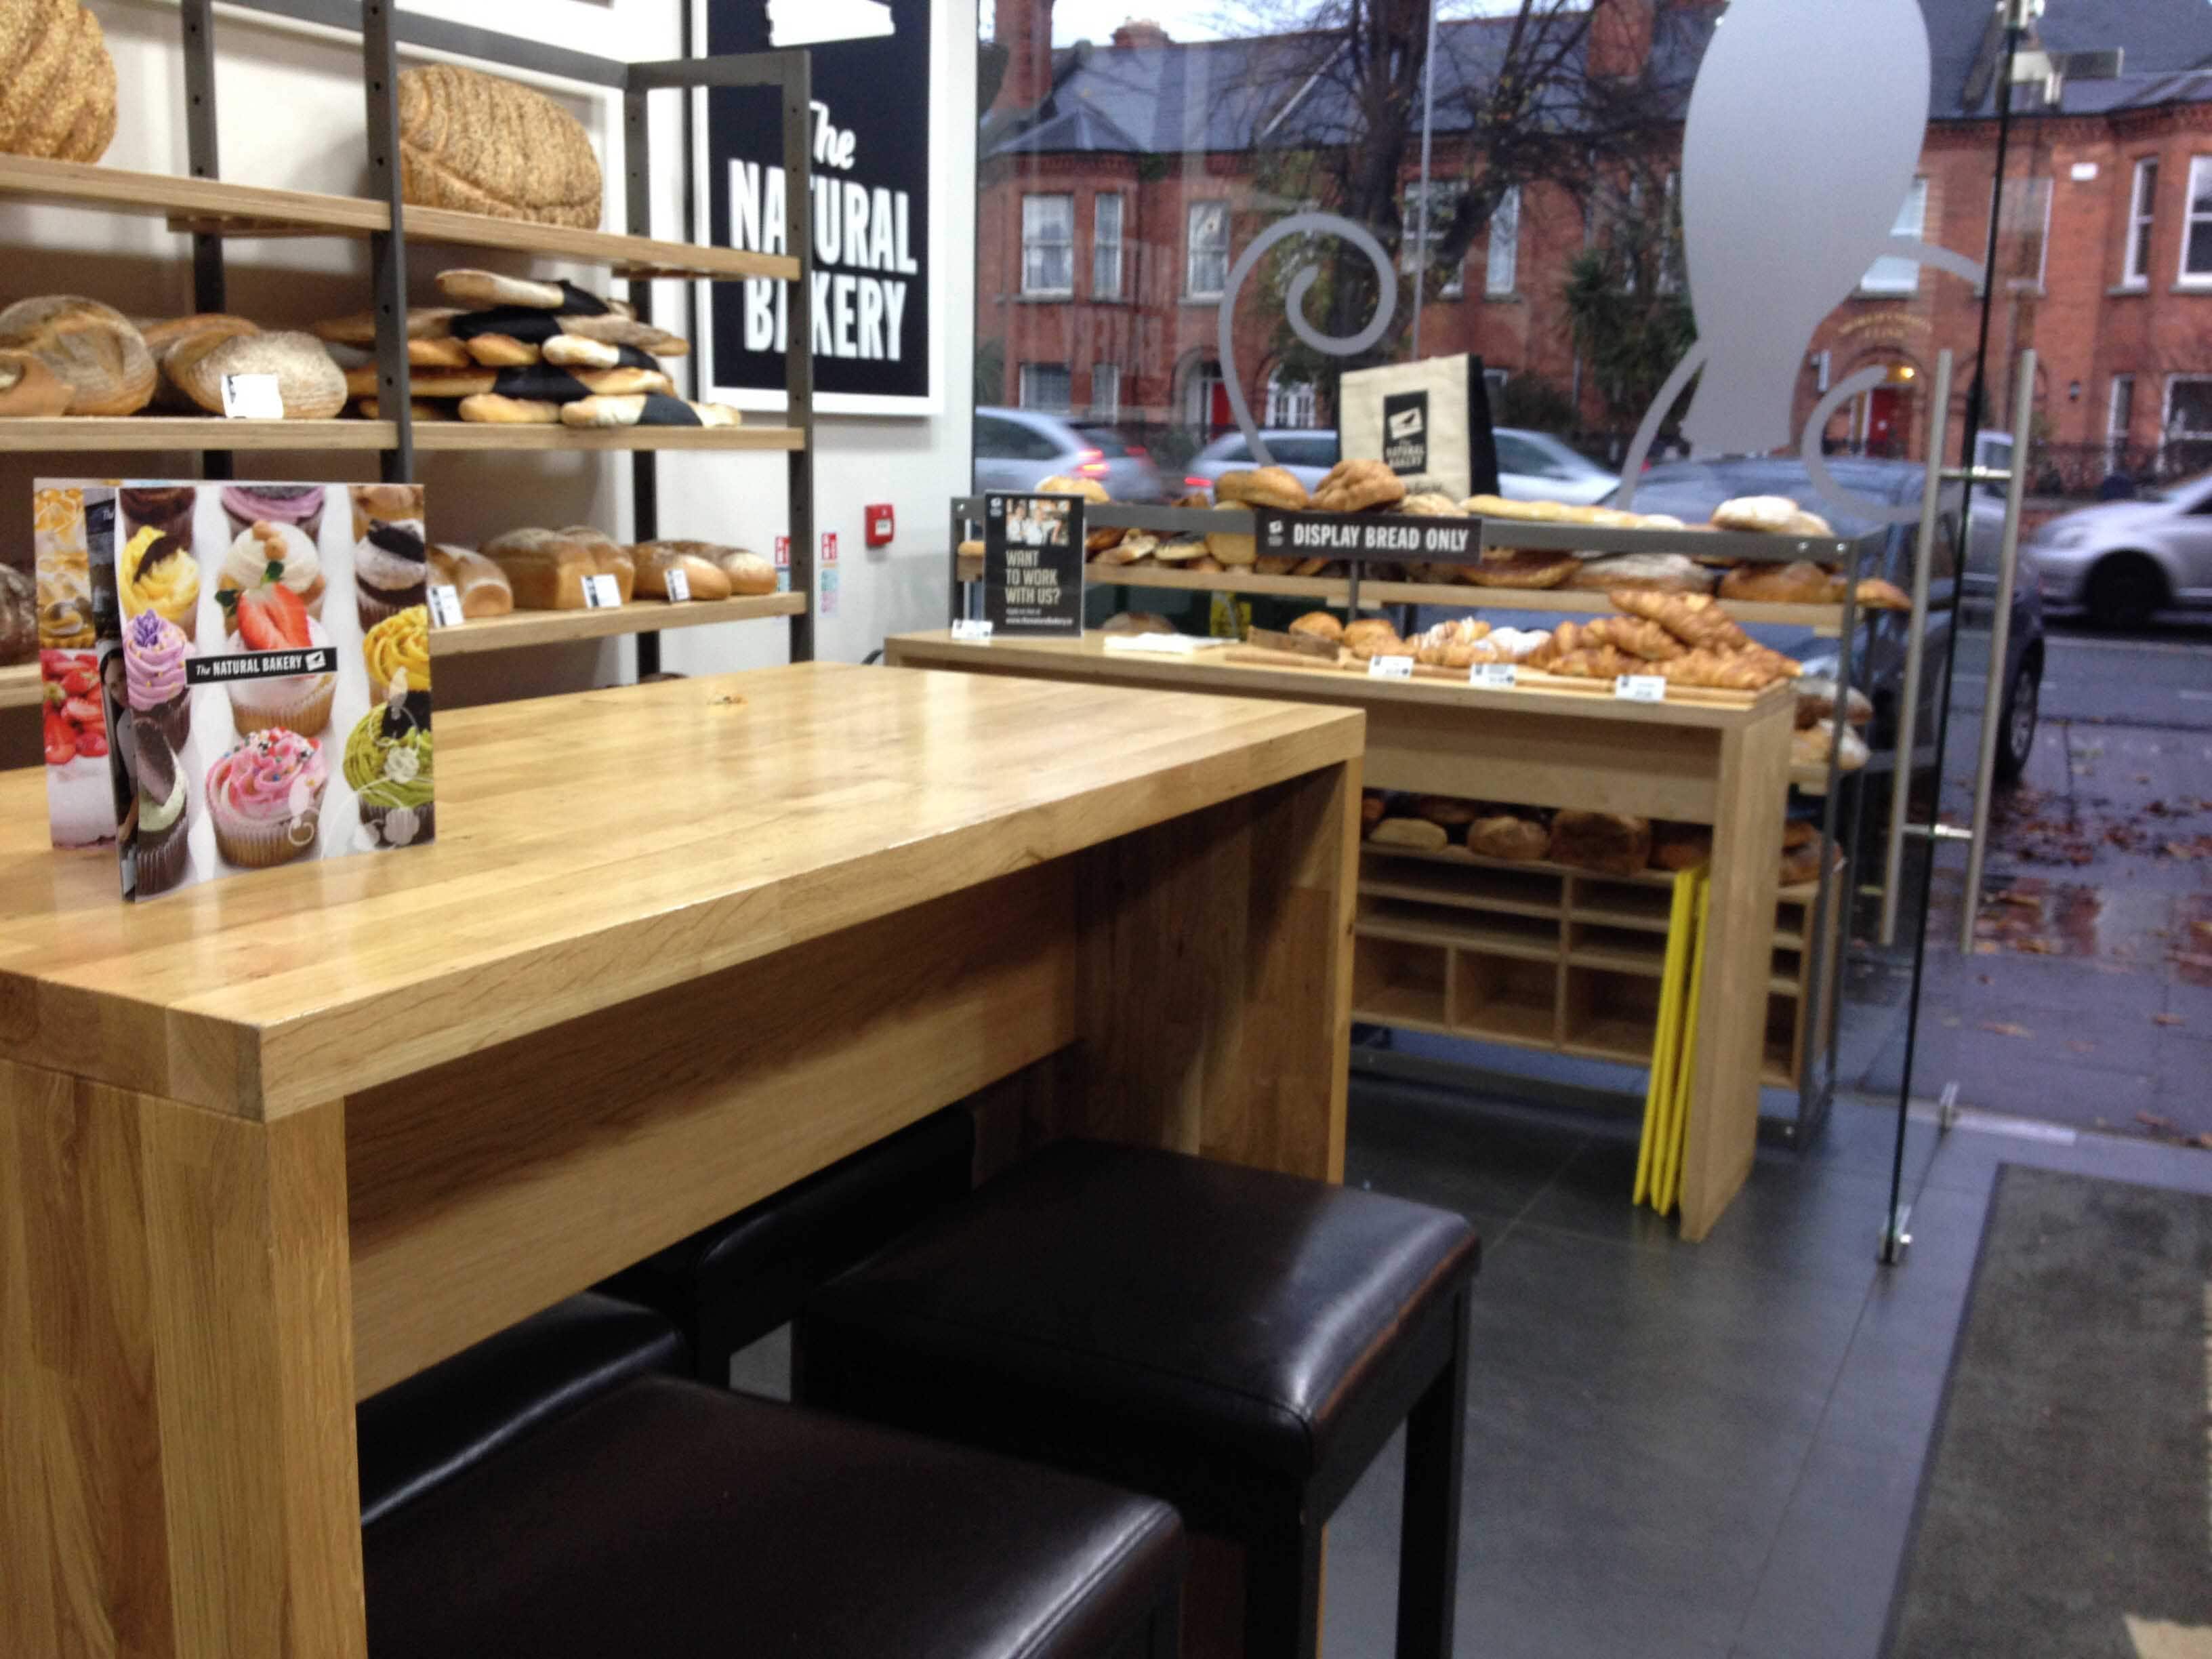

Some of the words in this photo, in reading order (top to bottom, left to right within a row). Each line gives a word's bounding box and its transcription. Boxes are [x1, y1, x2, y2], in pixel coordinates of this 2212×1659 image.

[809, 100, 856, 169] he
[728, 158, 918, 274] NAURAL
[1293, 523, 1360, 548] DISPLAY
[1365, 525, 1420, 550] BREAD
[1425, 527, 1469, 552] ONLY
[1006, 550, 1039, 567] WANT
[1006, 568, 1019, 586] TO
[1023, 569, 1058, 586] WORK
[1005, 587, 1034, 605] WITH
[1037, 587, 1062, 605] US?
[196, 664, 211, 676] The
[212, 657, 261, 676] NATURAL
[262, 655, 302, 672] BAKERY
